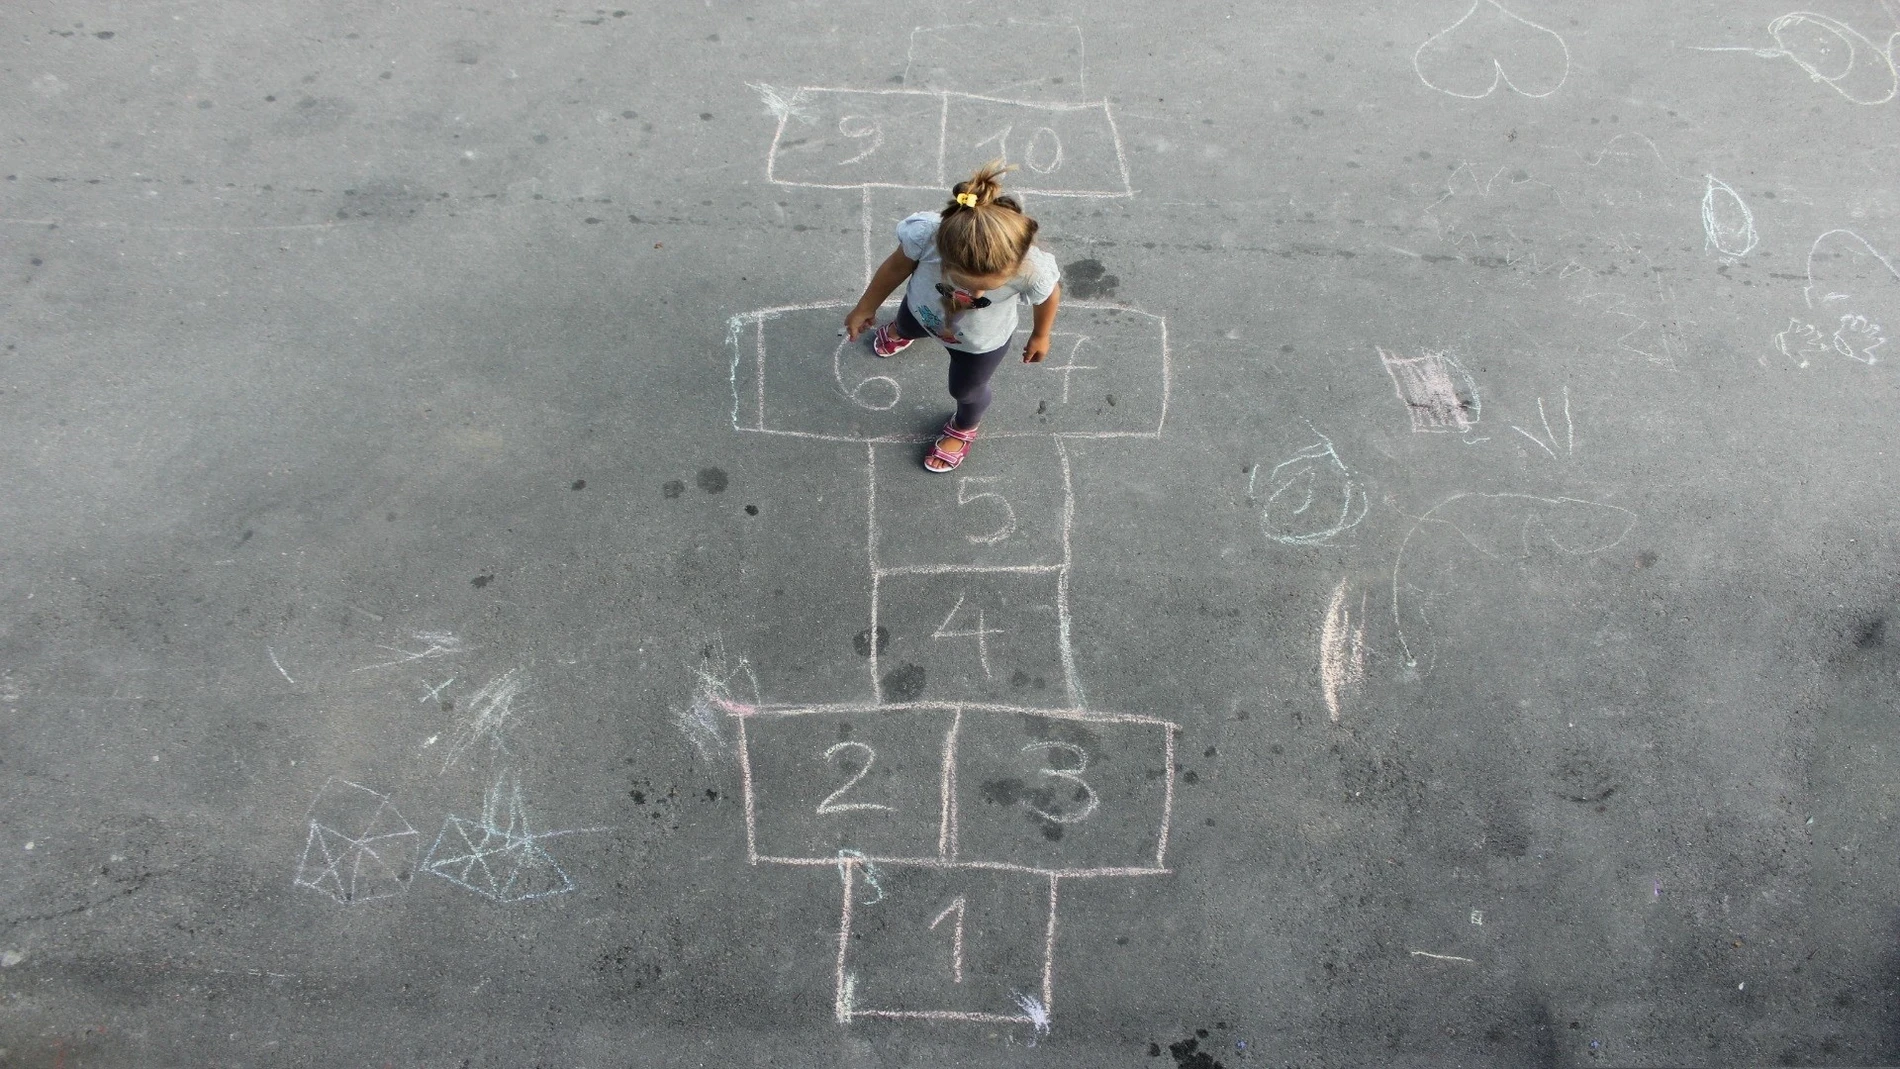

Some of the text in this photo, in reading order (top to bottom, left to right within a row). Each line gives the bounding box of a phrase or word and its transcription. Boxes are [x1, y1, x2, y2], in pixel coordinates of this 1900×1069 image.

[838, 115, 884, 166] 9
[974, 124, 1063, 176] 10
[834, 333, 901, 410] 6
[1016, 328, 1098, 404] 7
[957, 475, 1017, 544] 5
[931, 592, 1005, 679] 4
[816, 740, 898, 816] 2
[1020, 740, 1099, 823] 3
[929, 898, 966, 983] 1
